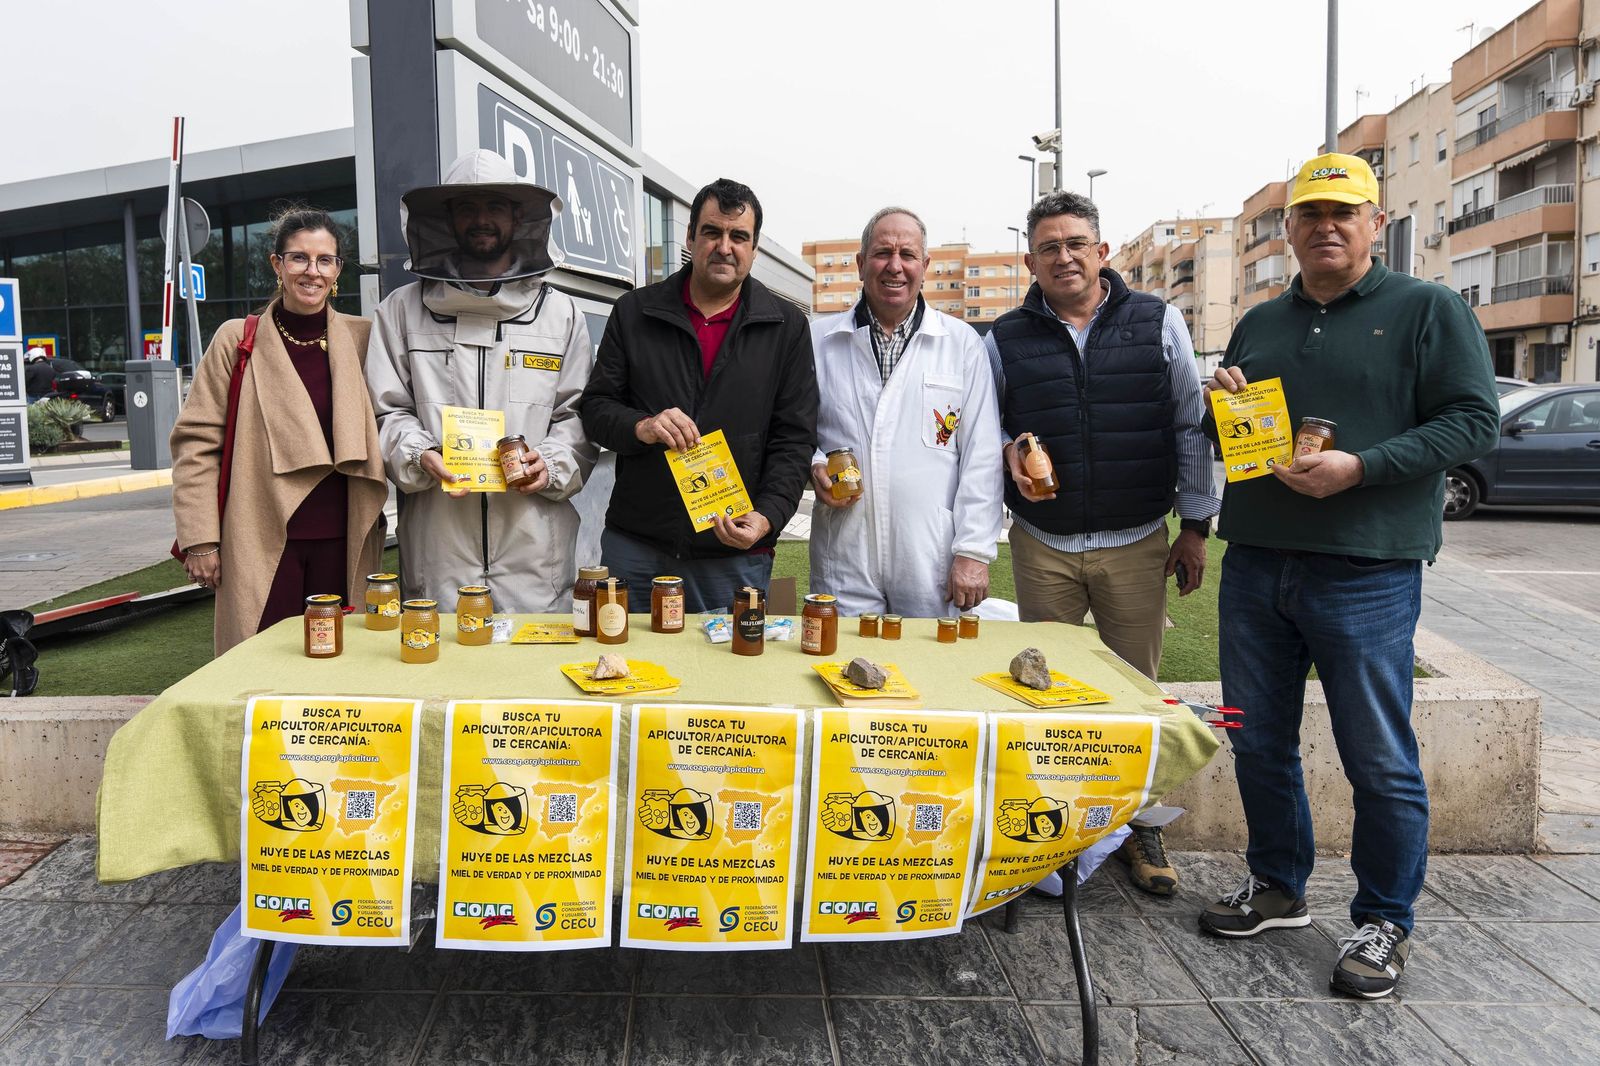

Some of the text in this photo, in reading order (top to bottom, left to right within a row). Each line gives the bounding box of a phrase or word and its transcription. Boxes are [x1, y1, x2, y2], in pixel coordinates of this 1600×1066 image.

[549, 6, 581, 61] 9:00
[592, 46, 624, 98] 21:30
[1313, 168, 1347, 176] COAG
[1262, 436, 1286, 444] MEZCLAS
[1231, 462, 1256, 471] COAG
[303, 708, 361, 718] BUSCA TU
[503, 713, 560, 722] BUSCA TU
[261, 721, 402, 733] APICULTOR/APICULTORA
[688, 719, 745, 729] BUSCA TU
[870, 722, 927, 732] BUSCA TU
[462, 725, 602, 737] APICULTOR/APICULTORA
[1046, 730, 1102, 740] BUSCA TU
[291, 734, 370, 746] DE CERCANÍA:
[648, 730, 787, 746] APICULTOR/APICULTORA
[830, 734, 968, 749] APICULTOR/APICULTORA
[493, 738, 570, 750] DE CERCANÍA:
[1006, 742, 1142, 754] APICULTOR/APICULTORA
[679, 746, 755, 757] DE CERCANÍA:
[861, 749, 938, 760] DE CERCANÍA:
[280, 753, 379, 763] www.coag.org/apicultura
[482, 758, 580, 766] www.coag.org/apicultura
[1037, 755, 1112, 766] DE CERCANÍA:
[668, 763, 765, 774] www.coag.org/apicultura
[850, 767, 946, 776] www.coag.org/apicultura
[261, 847, 390, 860] HUYE DE LAS MEZCLAS
[461, 852, 592, 863] HUYE DE LAS MEZCLAS
[1047, 851, 1064, 859] LAS
[647, 856, 775, 868] HUYE DE LAS MEZCLAS
[828, 857, 953, 866] HUYE DE LAS MEZCLAS
[251, 863, 269, 872] MIEL
[285, 866, 318, 875] VERDAD
[322, 867, 327, 875] Y
[344, 868, 399, 876] PROXIMIDAD
[1022, 864, 1050, 873] VERDAD
[451, 870, 470, 878] MIEL
[488, 871, 521, 879] VERDAD
[548, 870, 601, 879] PROXIMIDAD
[636, 872, 656, 880] MIEL
[672, 874, 706, 883] VERDAD
[732, 875, 784, 883] PROXIMIDAD
[255, 894, 311, 910] COAG
[454, 903, 512, 916] COAG
[639, 904, 698, 919] COAG
[820, 902, 877, 914] COAG
[357, 917, 393, 927] CECU
[920, 912, 951, 922] CECU
[561, 918, 596, 929] CECU
[744, 921, 777, 932] CECU
